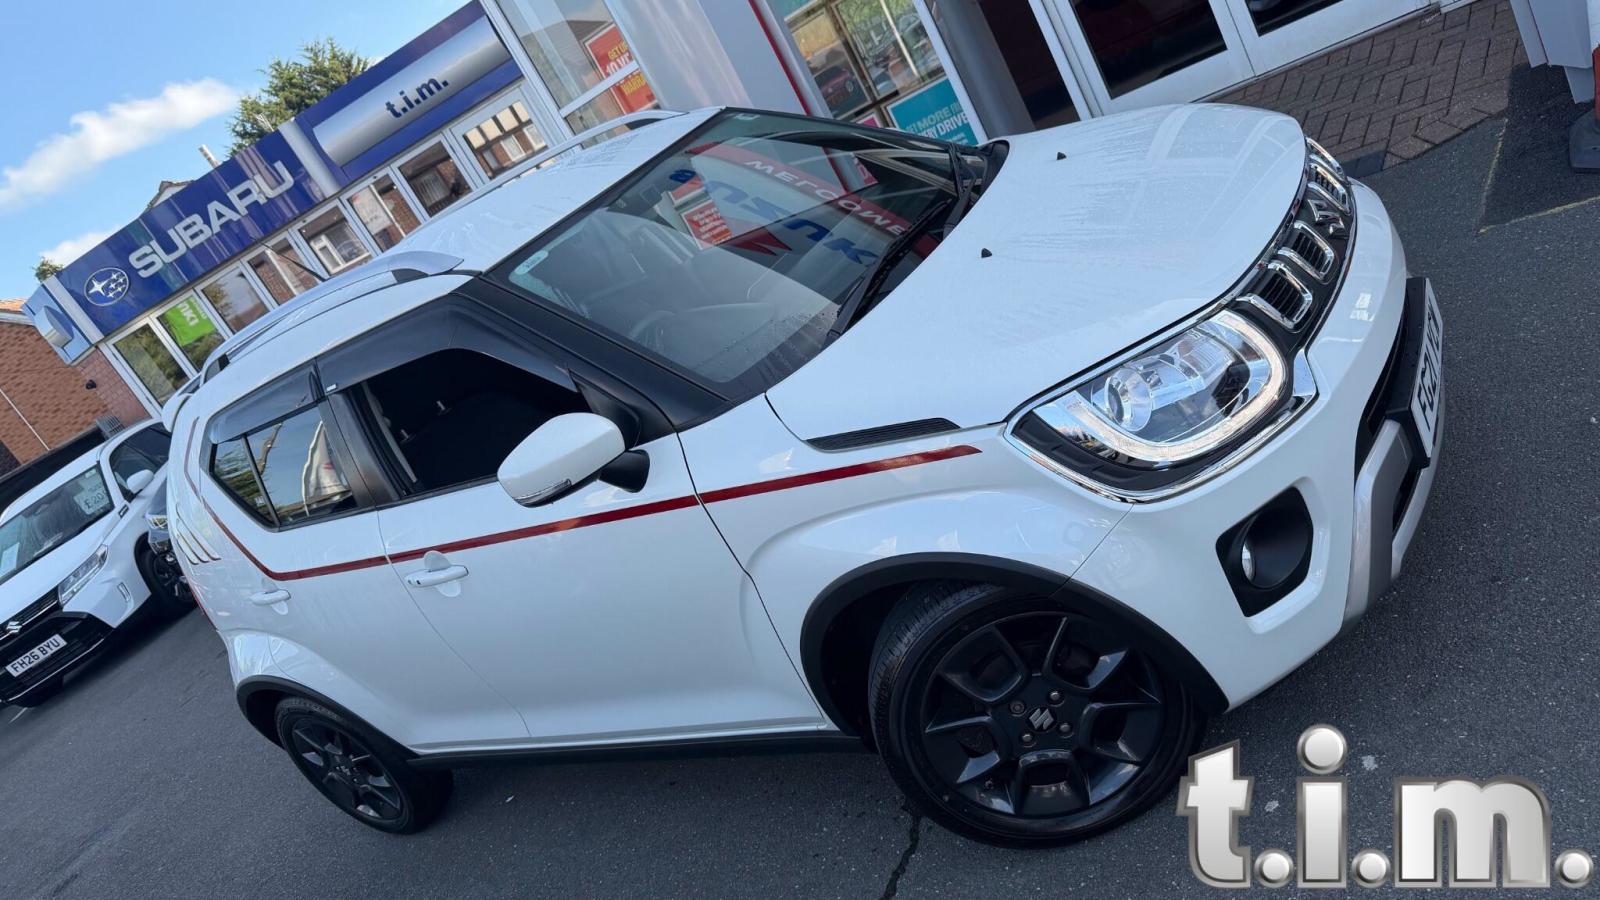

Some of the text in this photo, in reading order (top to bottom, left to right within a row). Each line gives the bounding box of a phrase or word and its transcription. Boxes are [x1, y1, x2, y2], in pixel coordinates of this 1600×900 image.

[385, 78, 449, 118] t.i.m.
[917, 106, 952, 131] MORE
[128, 160, 294, 278] SUBARU
[1418, 343, 1438, 431] FG21
[10, 637, 61, 672] FH26 BYU
